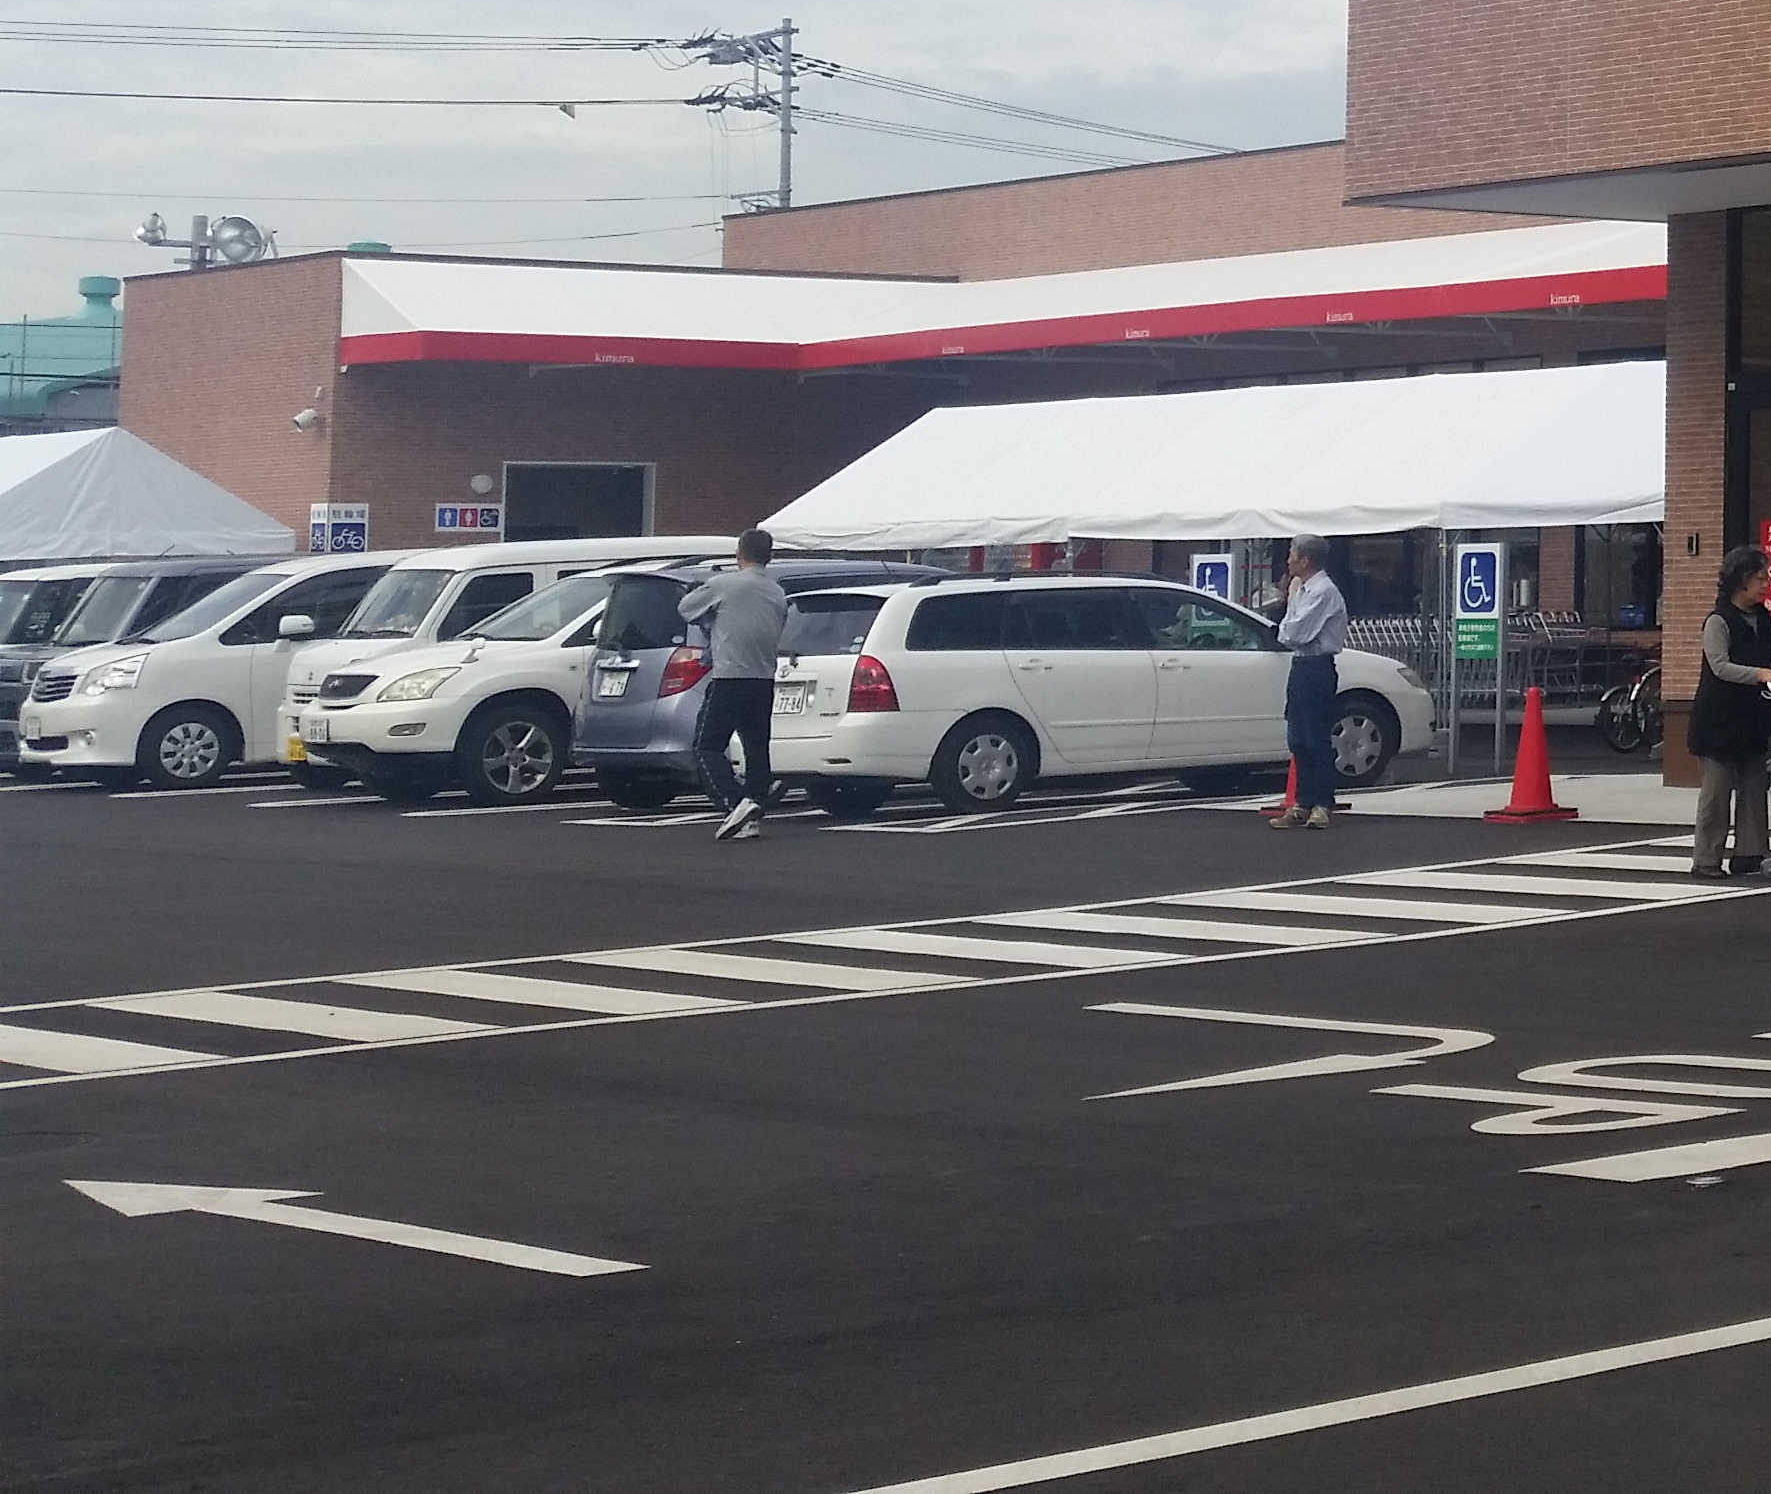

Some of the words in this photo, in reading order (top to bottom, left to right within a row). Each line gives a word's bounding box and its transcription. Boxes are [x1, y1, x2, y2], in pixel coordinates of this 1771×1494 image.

[1550, 293, 1580, 305] kimura
[1326, 311, 1354, 323] kimura
[595, 352, 635, 363] kimura
